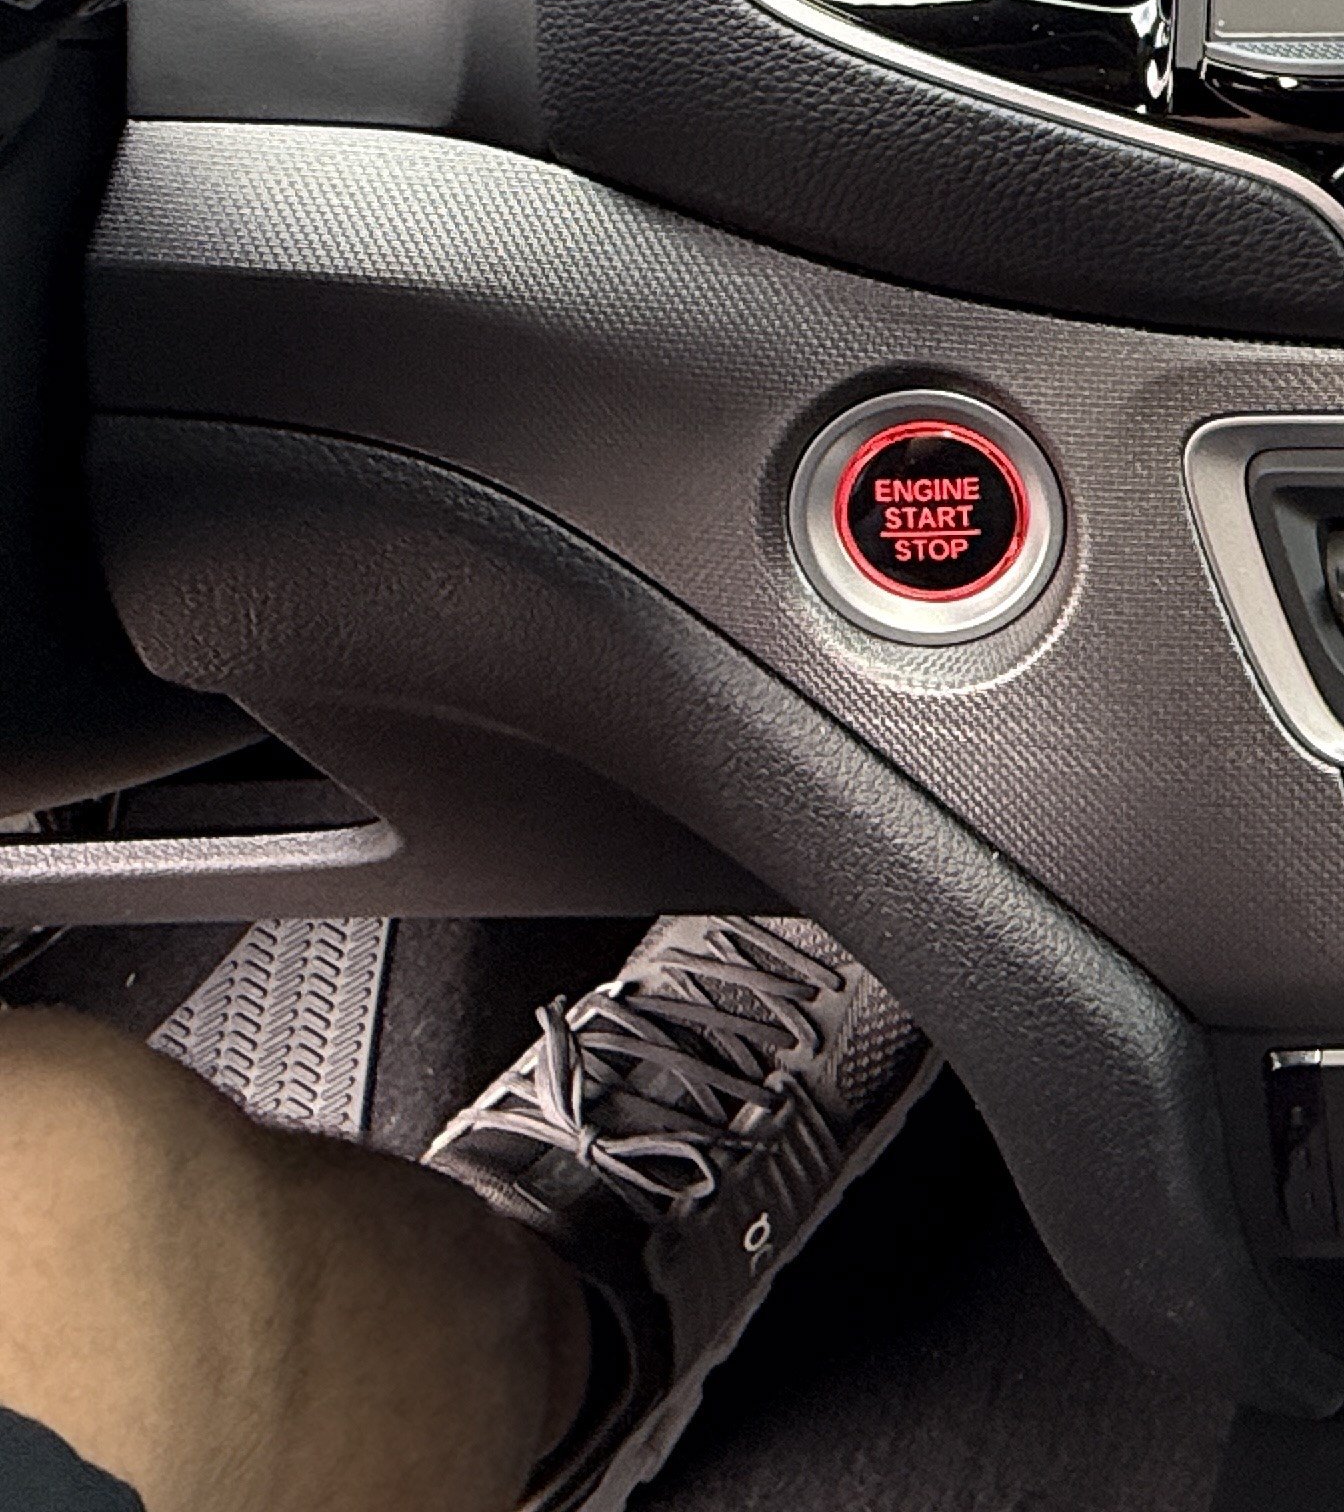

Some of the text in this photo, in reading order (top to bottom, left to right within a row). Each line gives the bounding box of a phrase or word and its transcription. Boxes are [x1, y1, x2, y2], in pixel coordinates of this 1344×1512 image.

[874, 476, 980, 503] ENGINE
[884, 504, 974, 530] START
[894, 538, 969, 562] STOP
